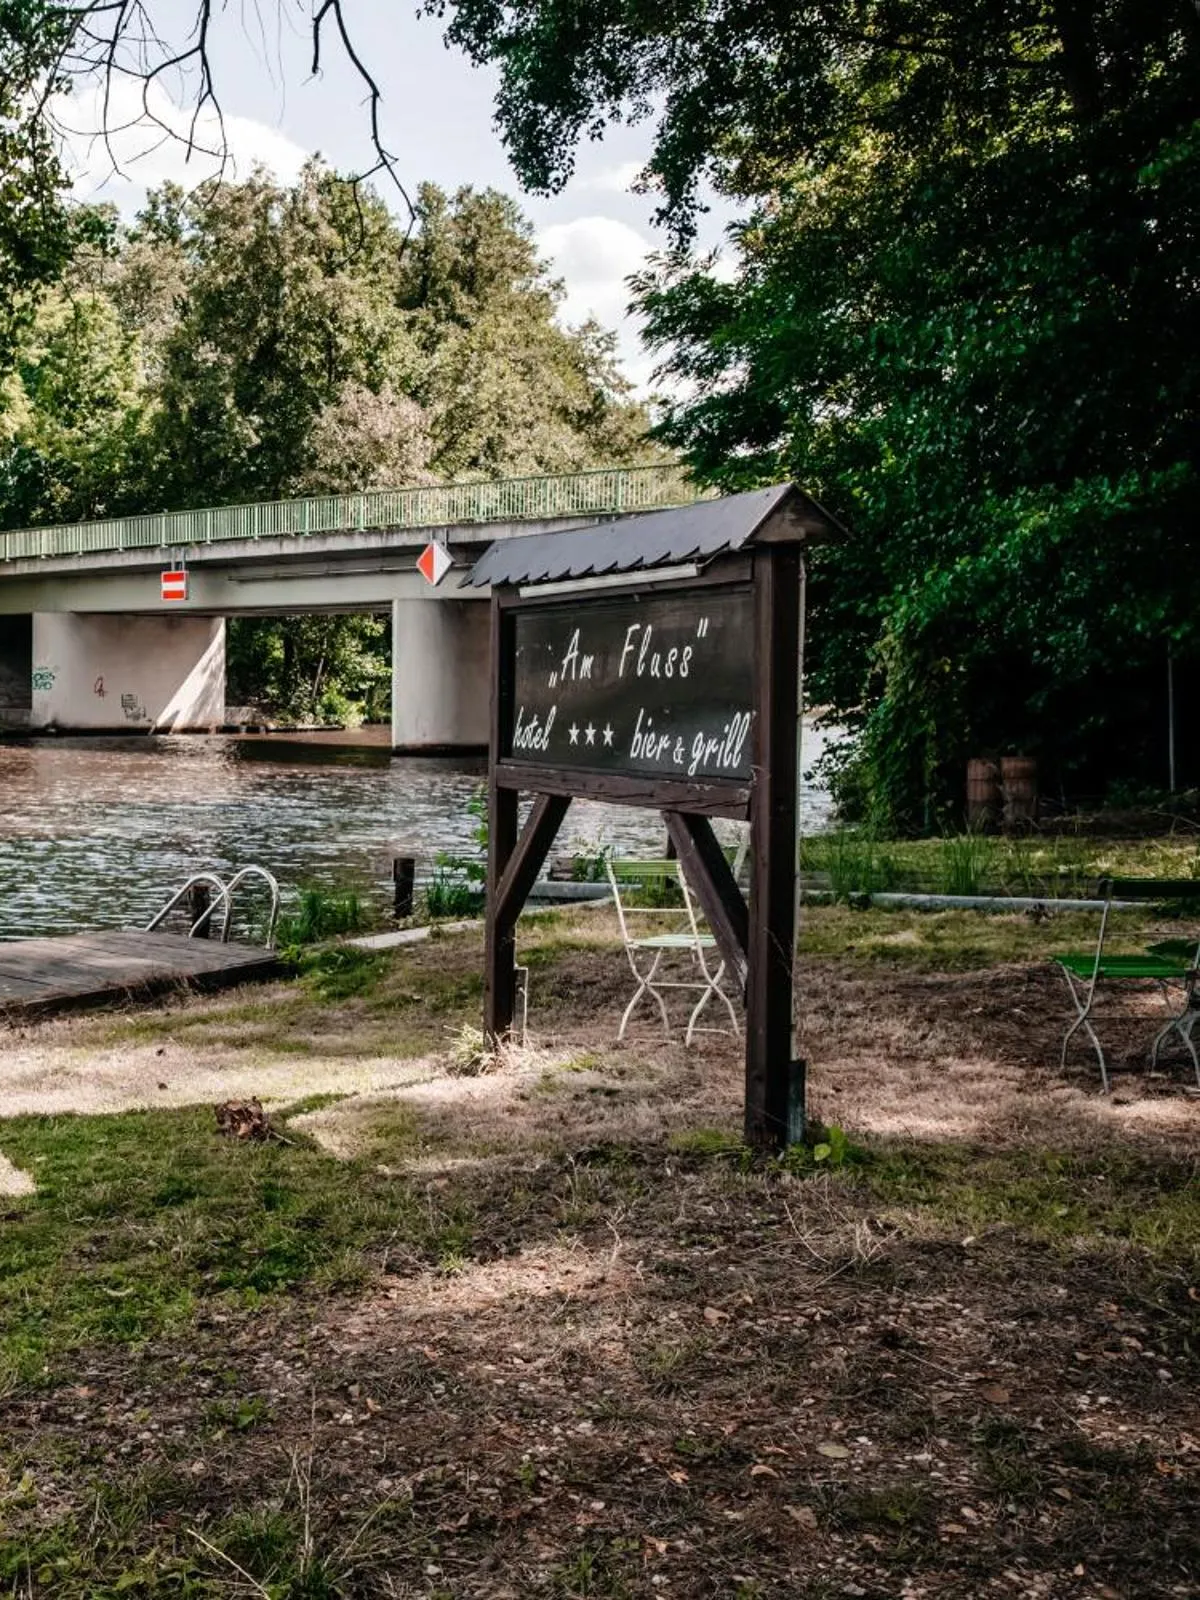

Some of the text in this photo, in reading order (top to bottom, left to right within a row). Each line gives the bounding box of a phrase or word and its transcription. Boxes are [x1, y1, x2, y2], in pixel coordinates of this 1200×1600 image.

[512, 704, 751, 777] hotel bier & grill
